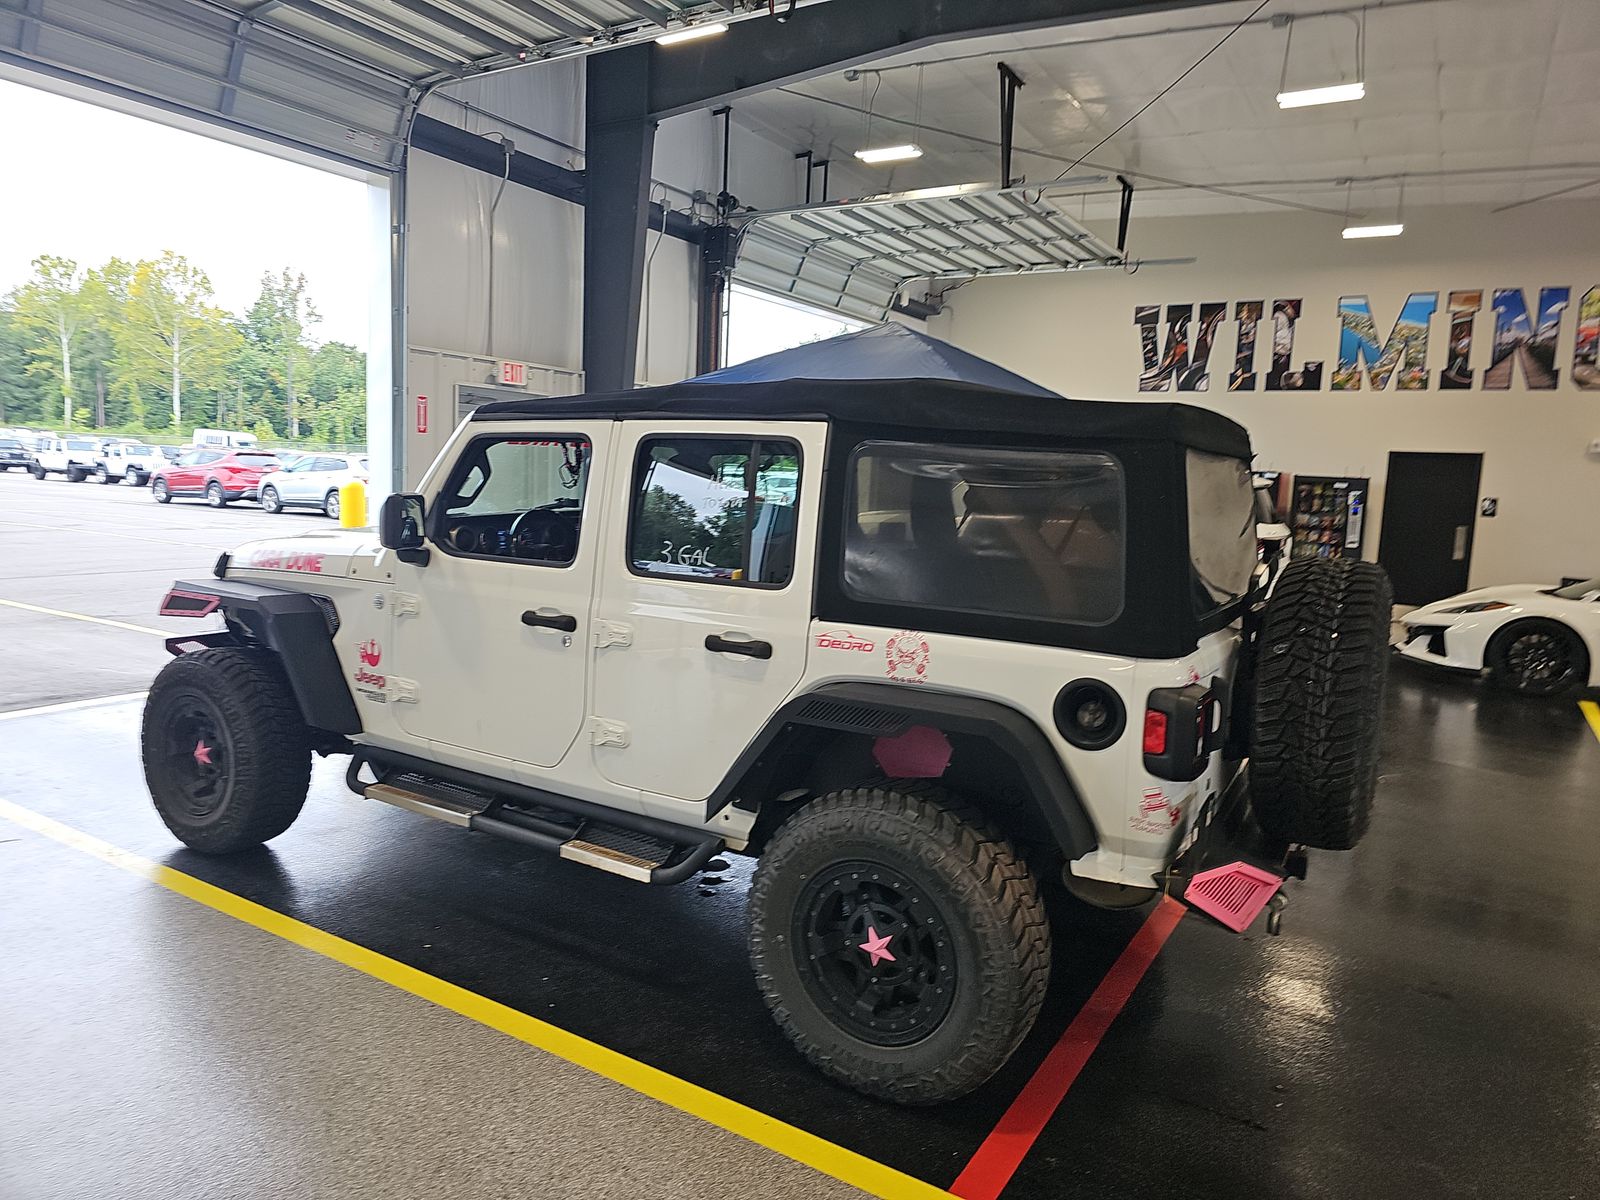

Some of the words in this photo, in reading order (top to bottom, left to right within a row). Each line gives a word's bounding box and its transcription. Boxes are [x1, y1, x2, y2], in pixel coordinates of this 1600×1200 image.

[504, 362, 524, 383] EXIT
[660, 540, 673, 564] 3
[677, 544, 716, 567] GAL
[354, 667, 386, 689] Jeep
